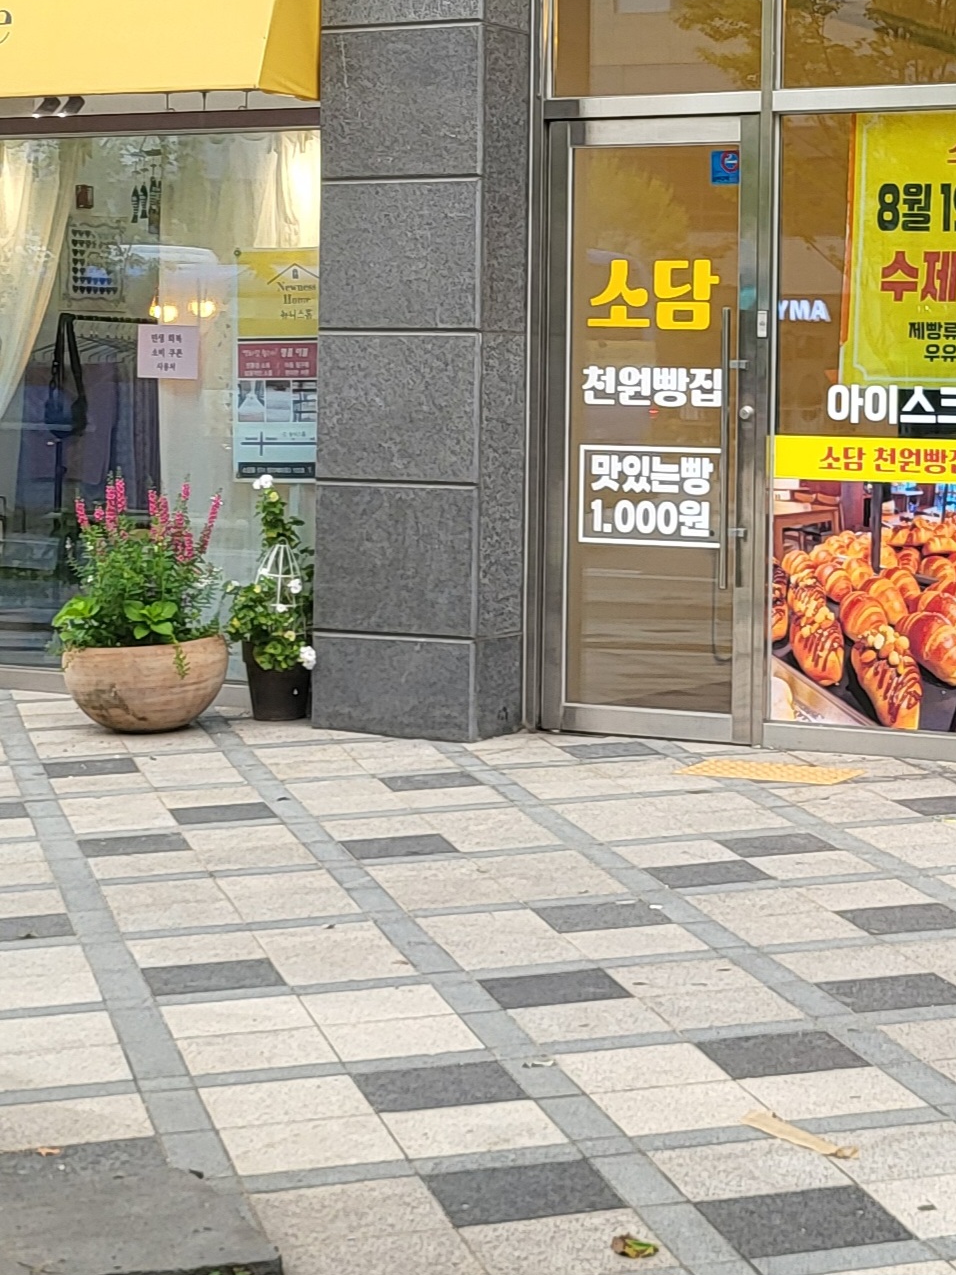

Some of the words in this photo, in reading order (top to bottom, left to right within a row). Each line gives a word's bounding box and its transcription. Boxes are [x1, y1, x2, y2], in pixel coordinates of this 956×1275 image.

[877, 183, 931, 232] 8월
[587, 259, 719, 331] 소담
[924, 344, 956, 362] 우유
[582, 366, 723, 407] 천원빵집
[591, 455, 713, 495] 맛있는빵
[819, 445, 866, 471] 소담
[591, 499, 711, 538] 1.000원
